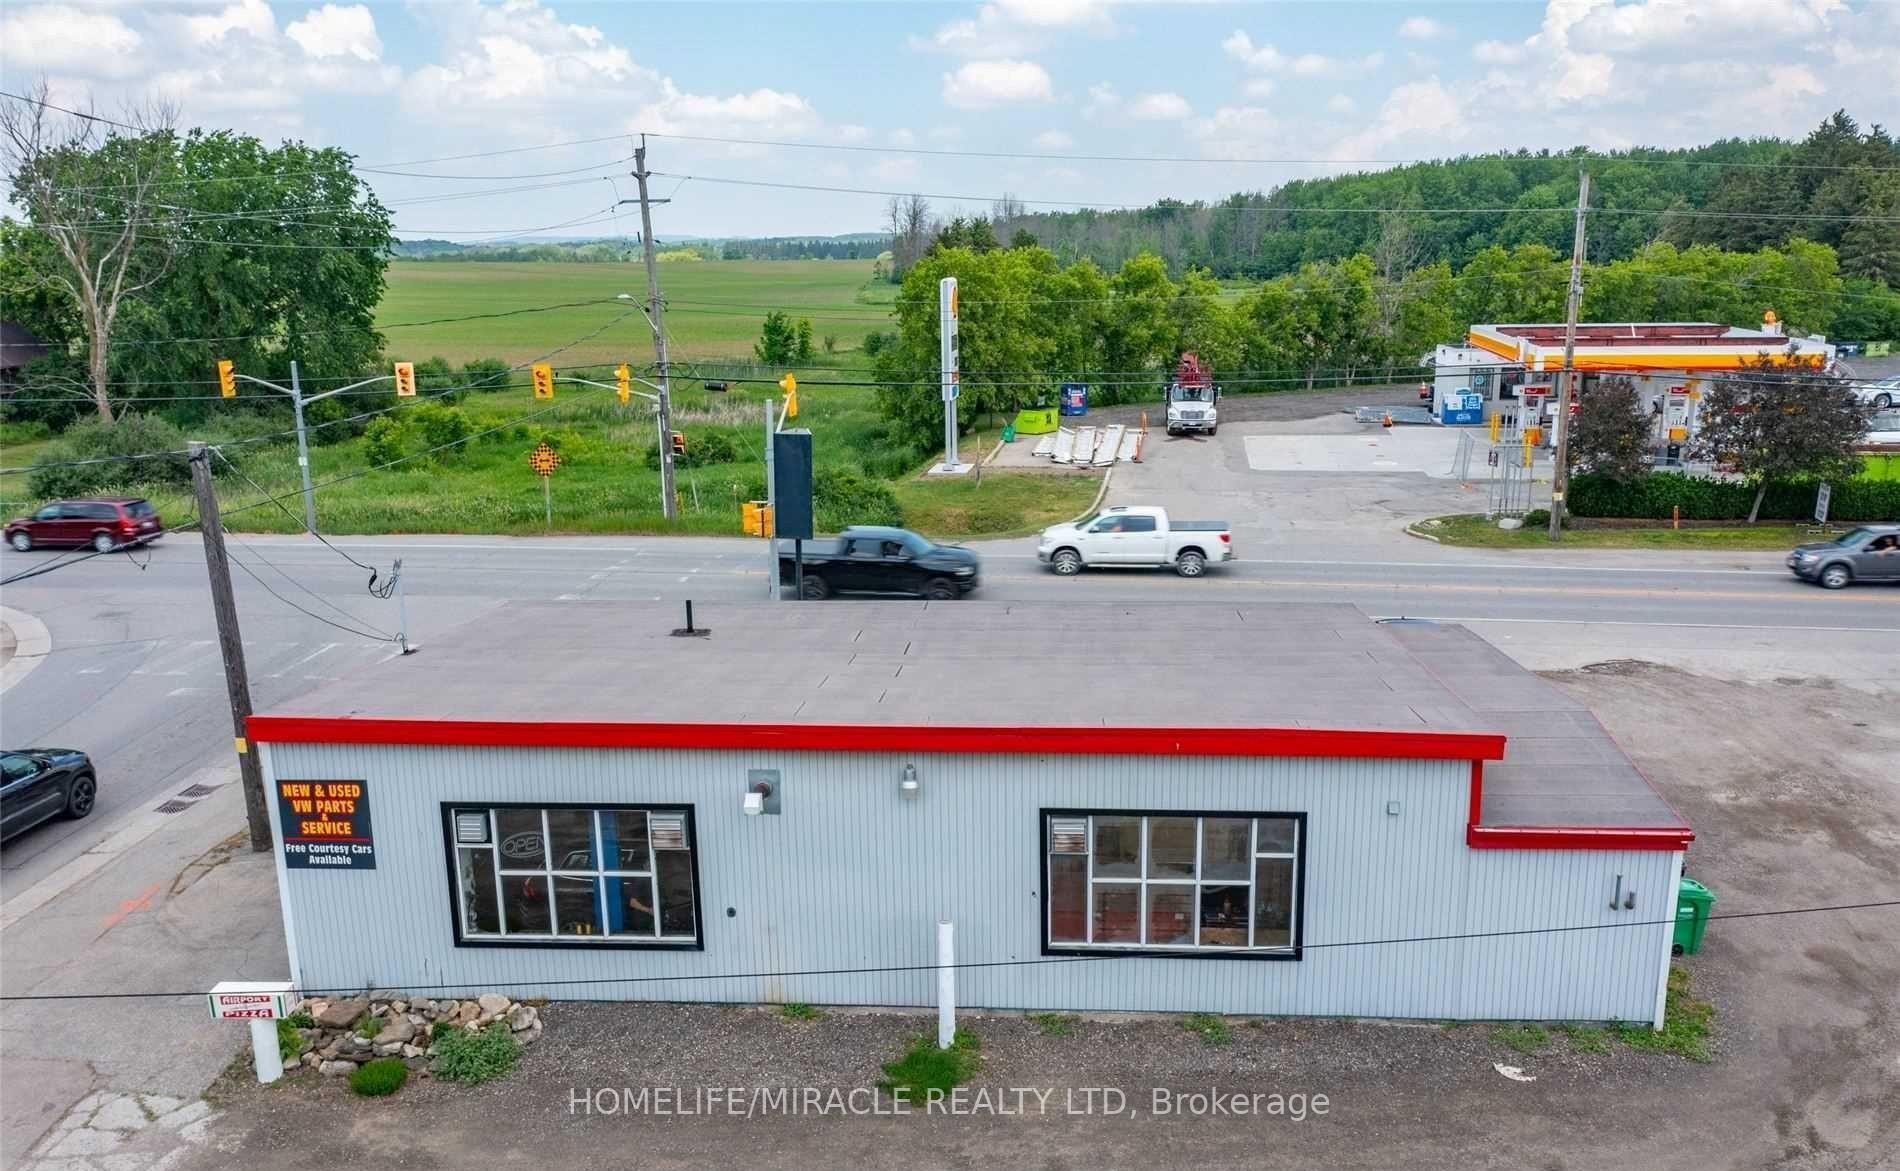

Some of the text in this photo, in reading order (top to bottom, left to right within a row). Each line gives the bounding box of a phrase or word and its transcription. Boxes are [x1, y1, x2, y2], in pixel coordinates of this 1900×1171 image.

[282, 784, 361, 798] NEW & USED
[292, 800, 355, 813] VW PARTS
[321, 813, 328, 821] &
[301, 822, 352, 835] SERVICE
[286, 843, 372, 855] Free Courtesy Cars
[309, 855, 352, 865] Available
[225, 1009, 270, 1017] PIZZA
